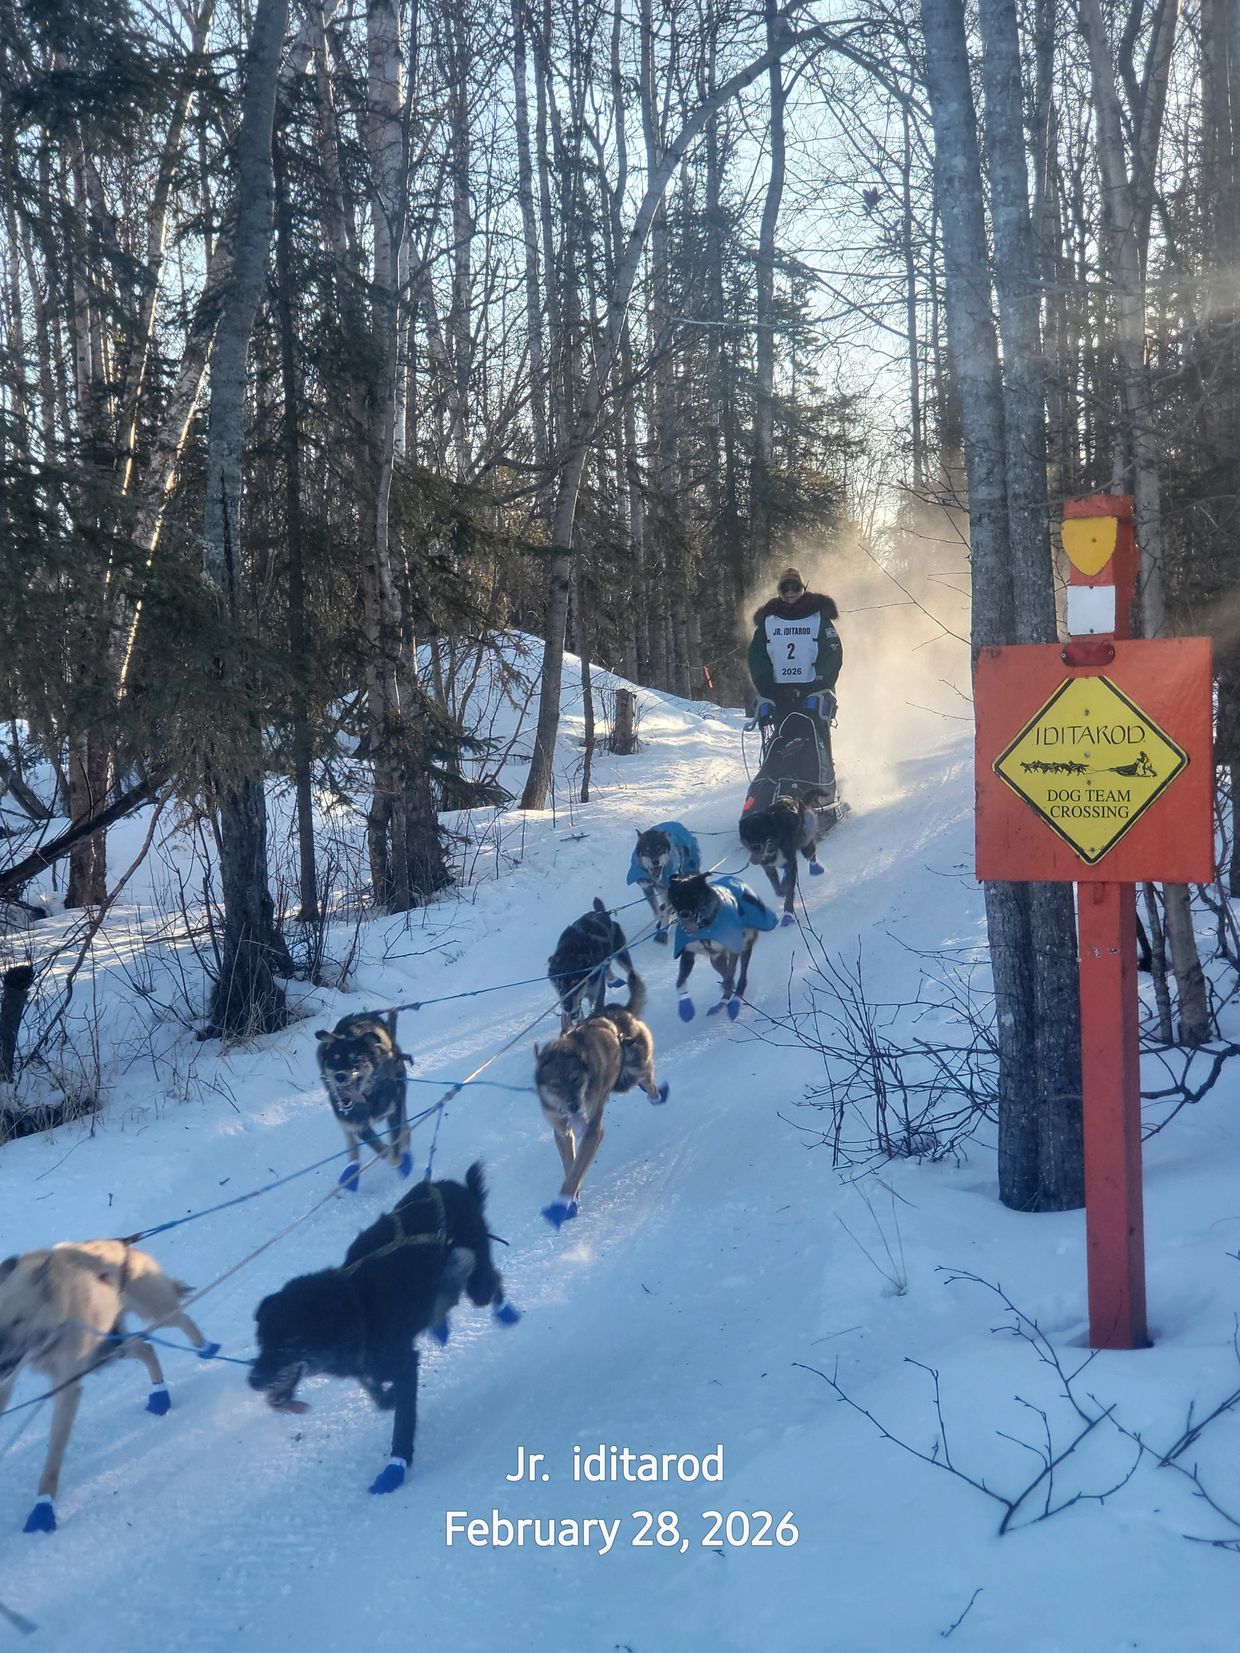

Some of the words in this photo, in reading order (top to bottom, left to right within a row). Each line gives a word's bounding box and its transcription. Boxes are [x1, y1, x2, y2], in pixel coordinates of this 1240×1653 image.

[784, 627, 810, 636] IDITAROD
[787, 643, 795, 660] 2
[1035, 725, 1145, 745] IDITAROD
[1047, 789, 1081, 802] DOG
[1085, 789, 1131, 802] TEAM
[1050, 806, 1129, 818] CROSSING
